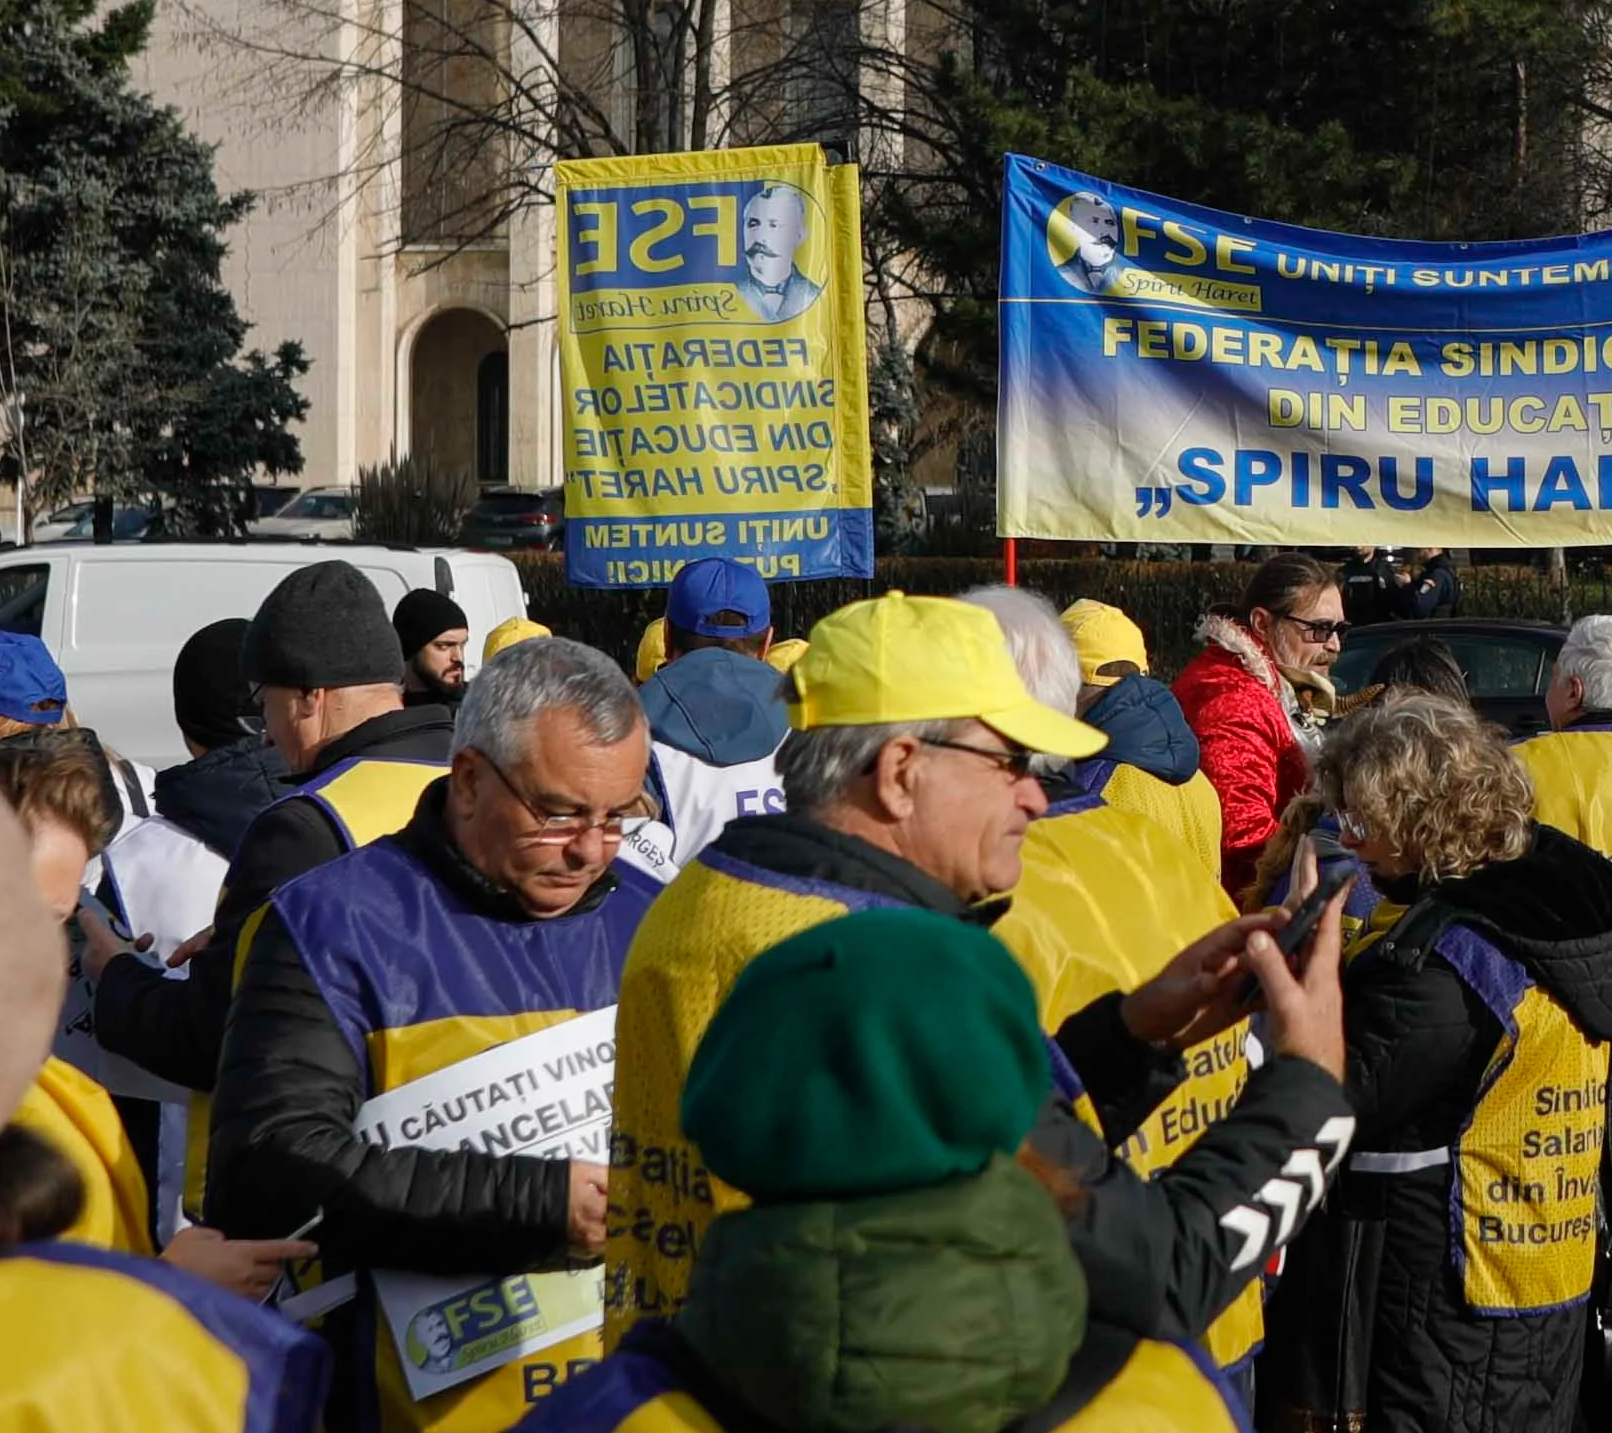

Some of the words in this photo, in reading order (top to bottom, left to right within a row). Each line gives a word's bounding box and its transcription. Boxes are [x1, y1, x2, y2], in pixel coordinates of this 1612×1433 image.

[1122, 208, 1258, 274] FSE
[1123, 268, 1185, 297] Spiru
[1191, 277, 1259, 305] Haret
[1277, 253, 1396, 295] UNIȚI
[1411, 259, 1609, 287] SUNTEM
[1102, 317, 1422, 387] FEDERAȚIA
[1267, 388, 1368, 432] DIN
[443, 1273, 540, 1341] FSE
